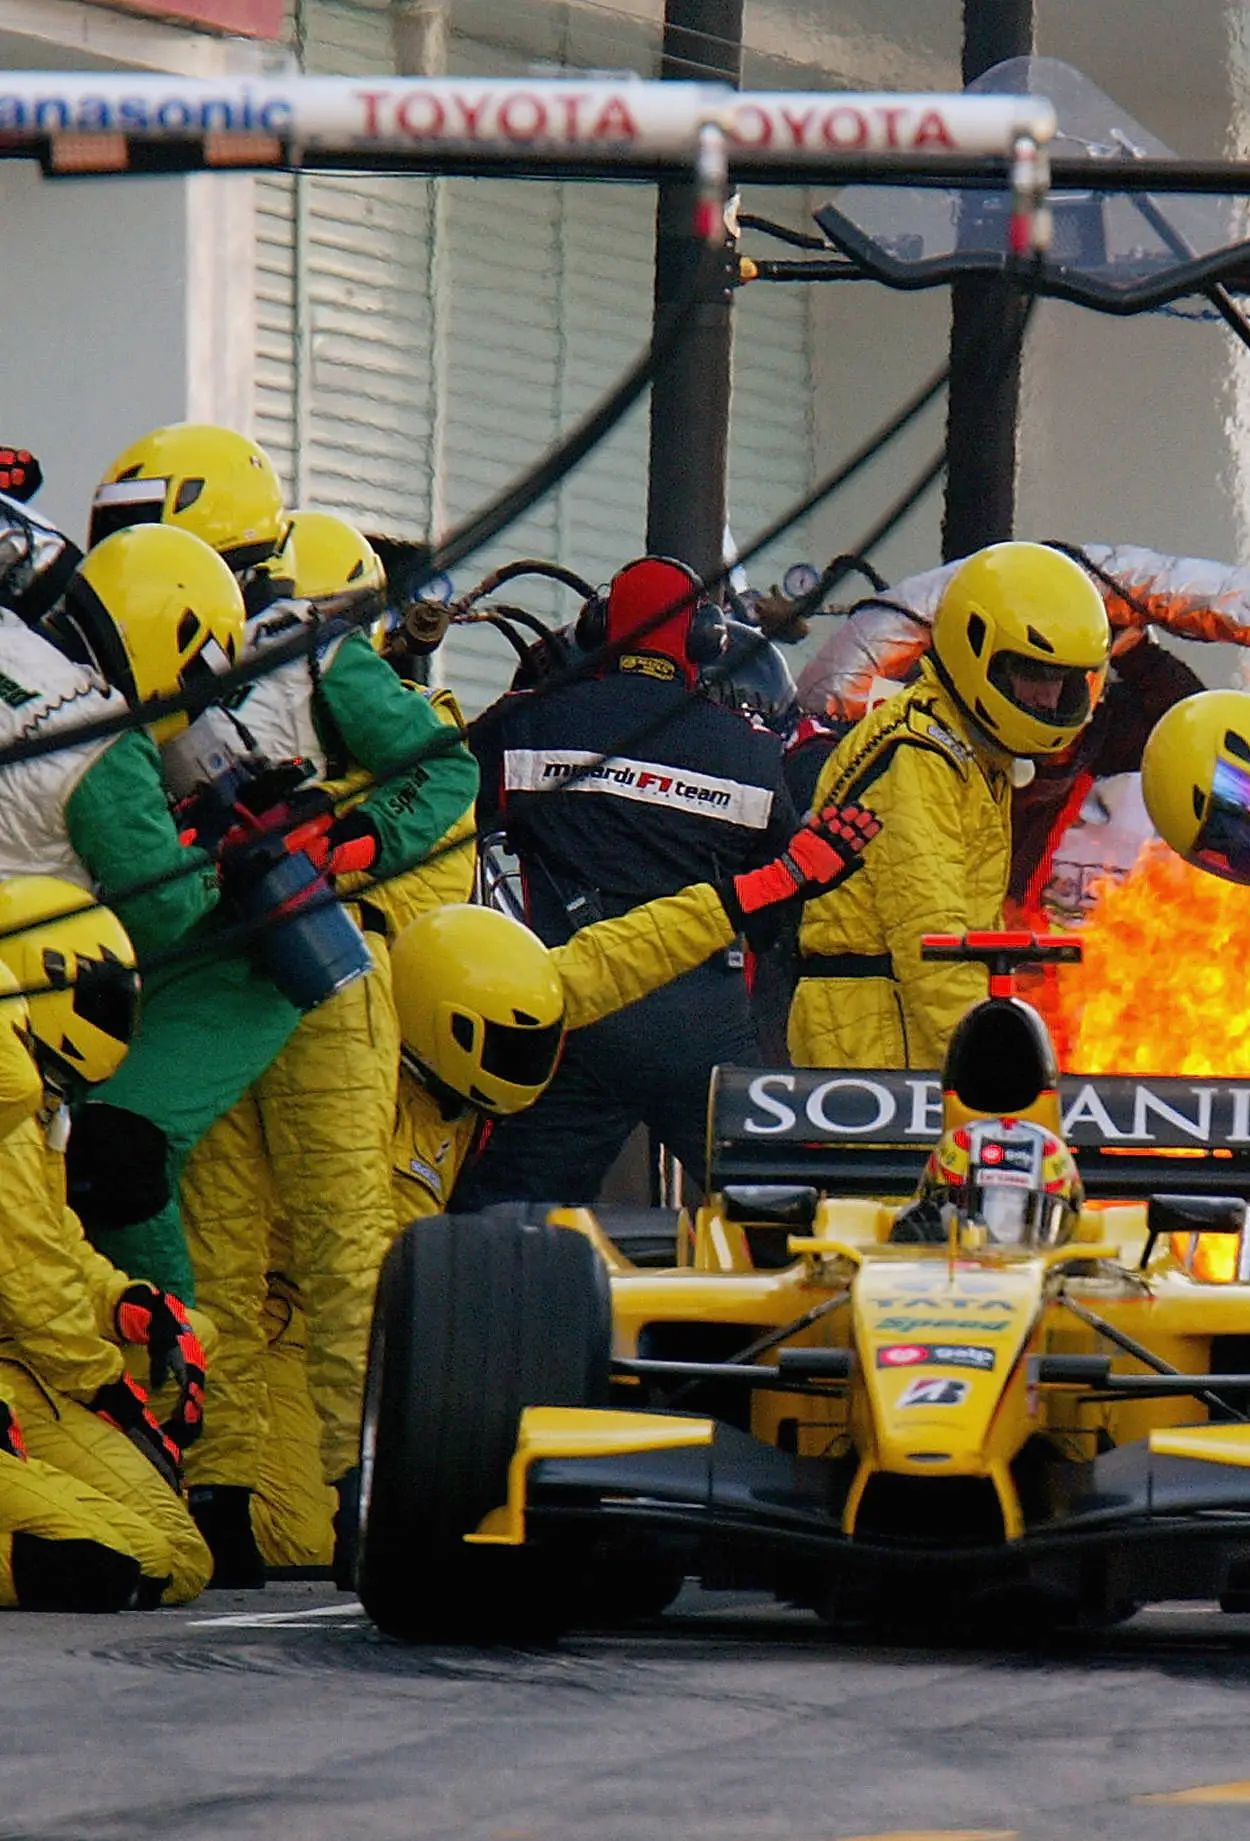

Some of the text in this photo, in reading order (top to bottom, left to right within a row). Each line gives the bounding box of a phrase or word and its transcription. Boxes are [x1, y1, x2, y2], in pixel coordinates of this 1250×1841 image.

[353, 91, 640, 142] TOYOTA
[727, 104, 960, 150] OYOTA
[636, 771, 673, 793] F1
[675, 780, 731, 807] team
[872, 1297, 1016, 1312] TATA
